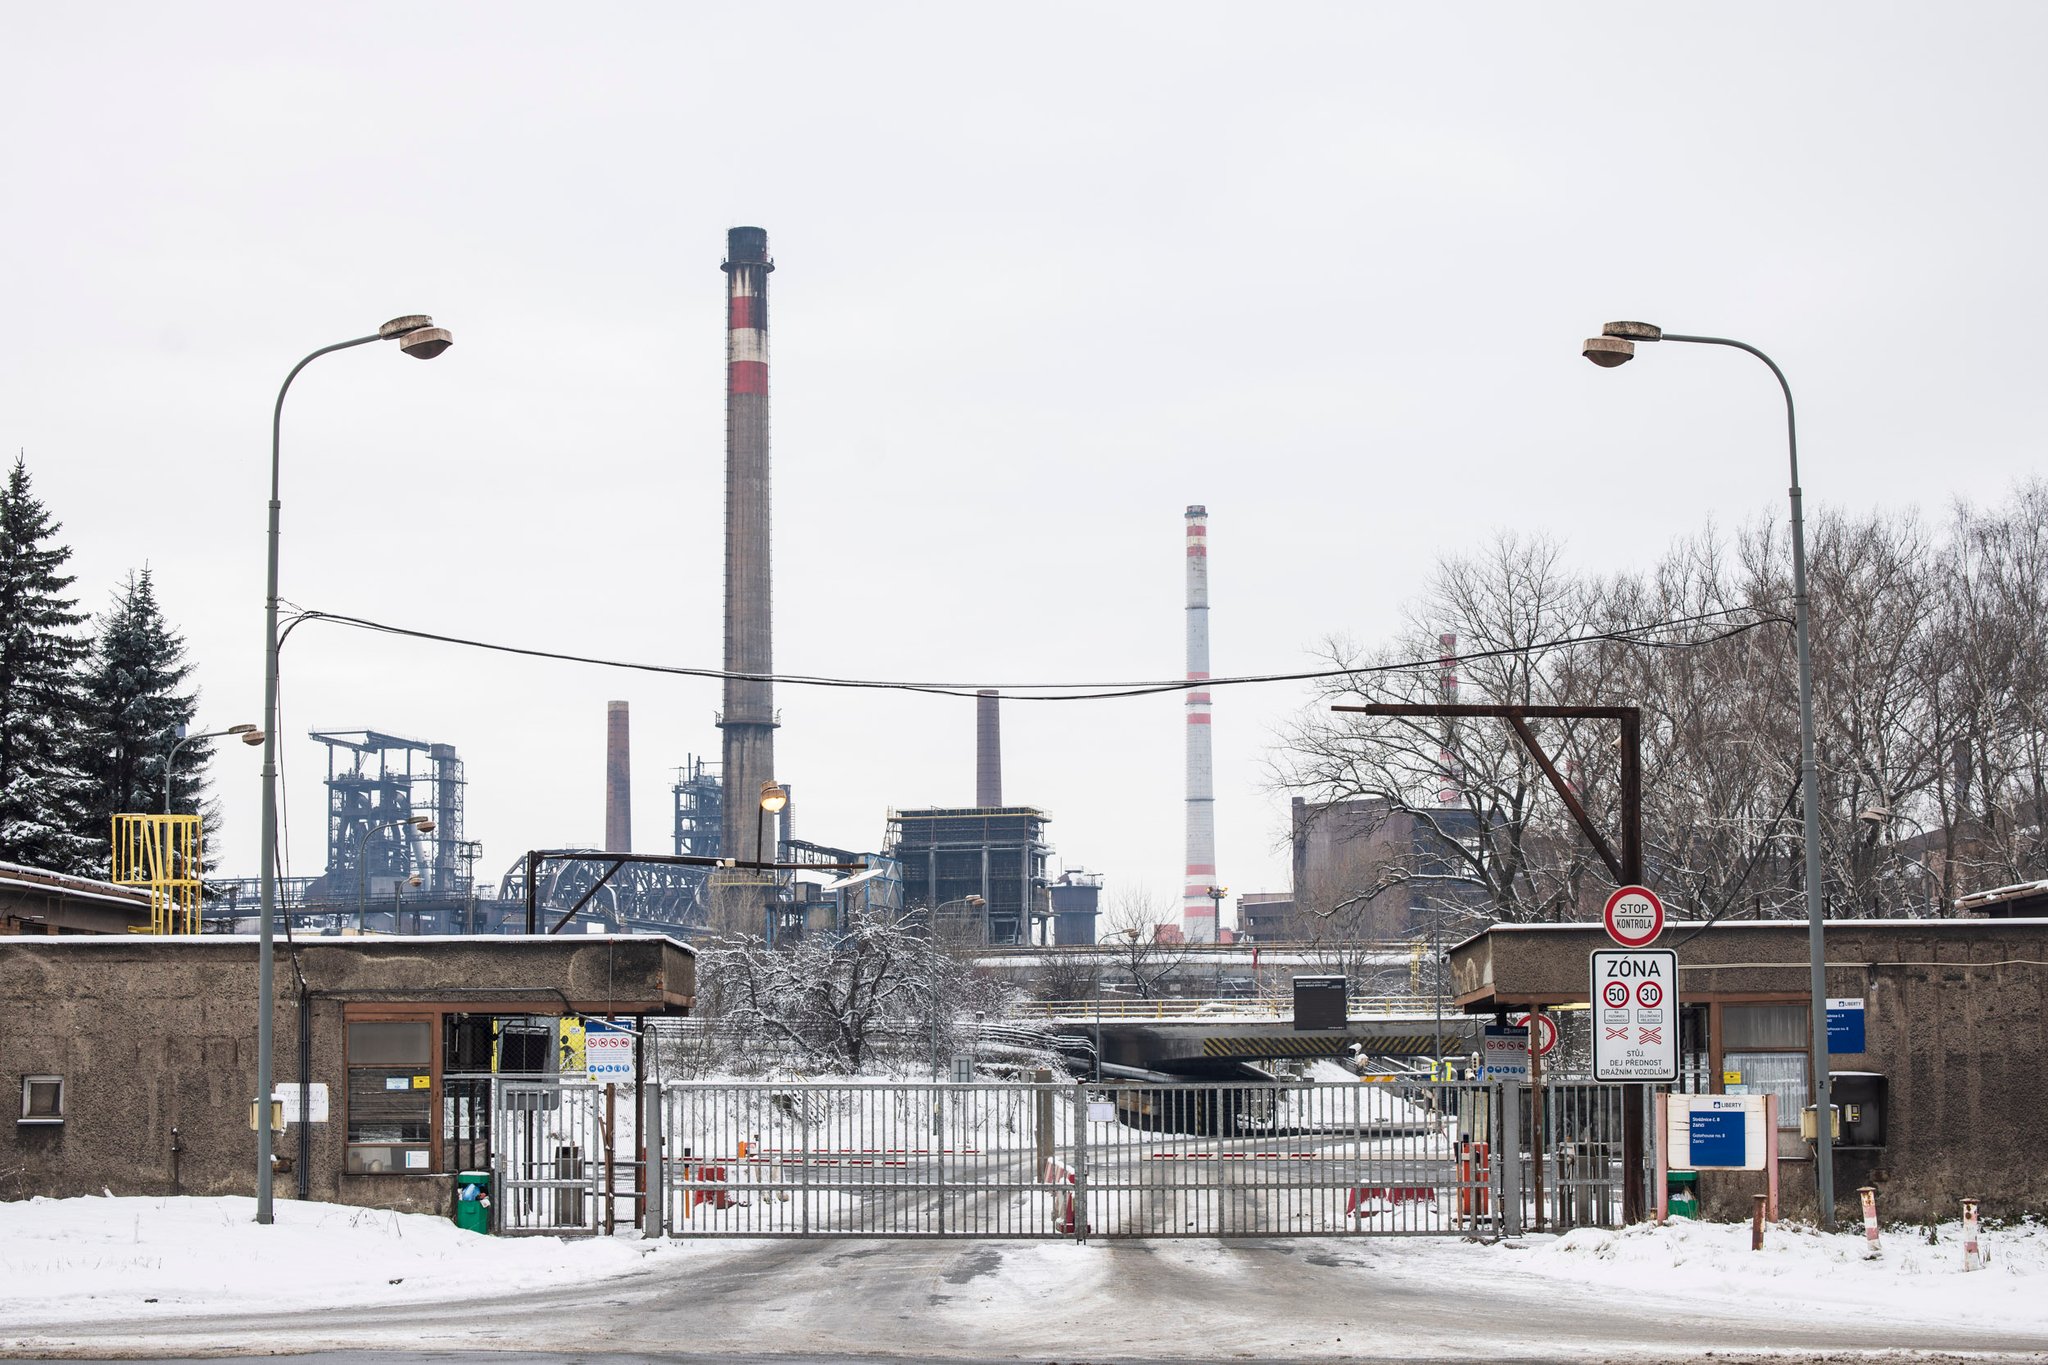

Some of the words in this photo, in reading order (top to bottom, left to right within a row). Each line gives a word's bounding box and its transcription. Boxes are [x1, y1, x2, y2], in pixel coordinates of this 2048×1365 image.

[1620, 903, 1649, 914] STOP
[1616, 919, 1652, 929] KONTROLA
[1607, 956, 1661, 977] ZÓNA
[1609, 988, 1625, 1001] 50
[1641, 988, 1658, 1001] 30
[1609, 1059, 1623, 1067] DEJ
[1625, 1058, 1663, 1067] PŘEDNOST
[1600, 1067, 1632, 1076] DRÁŽNÍM
[1634, 1067, 1671, 1076] VOZIDLŮM!
[1820, 1080, 1824, 1088] 2
